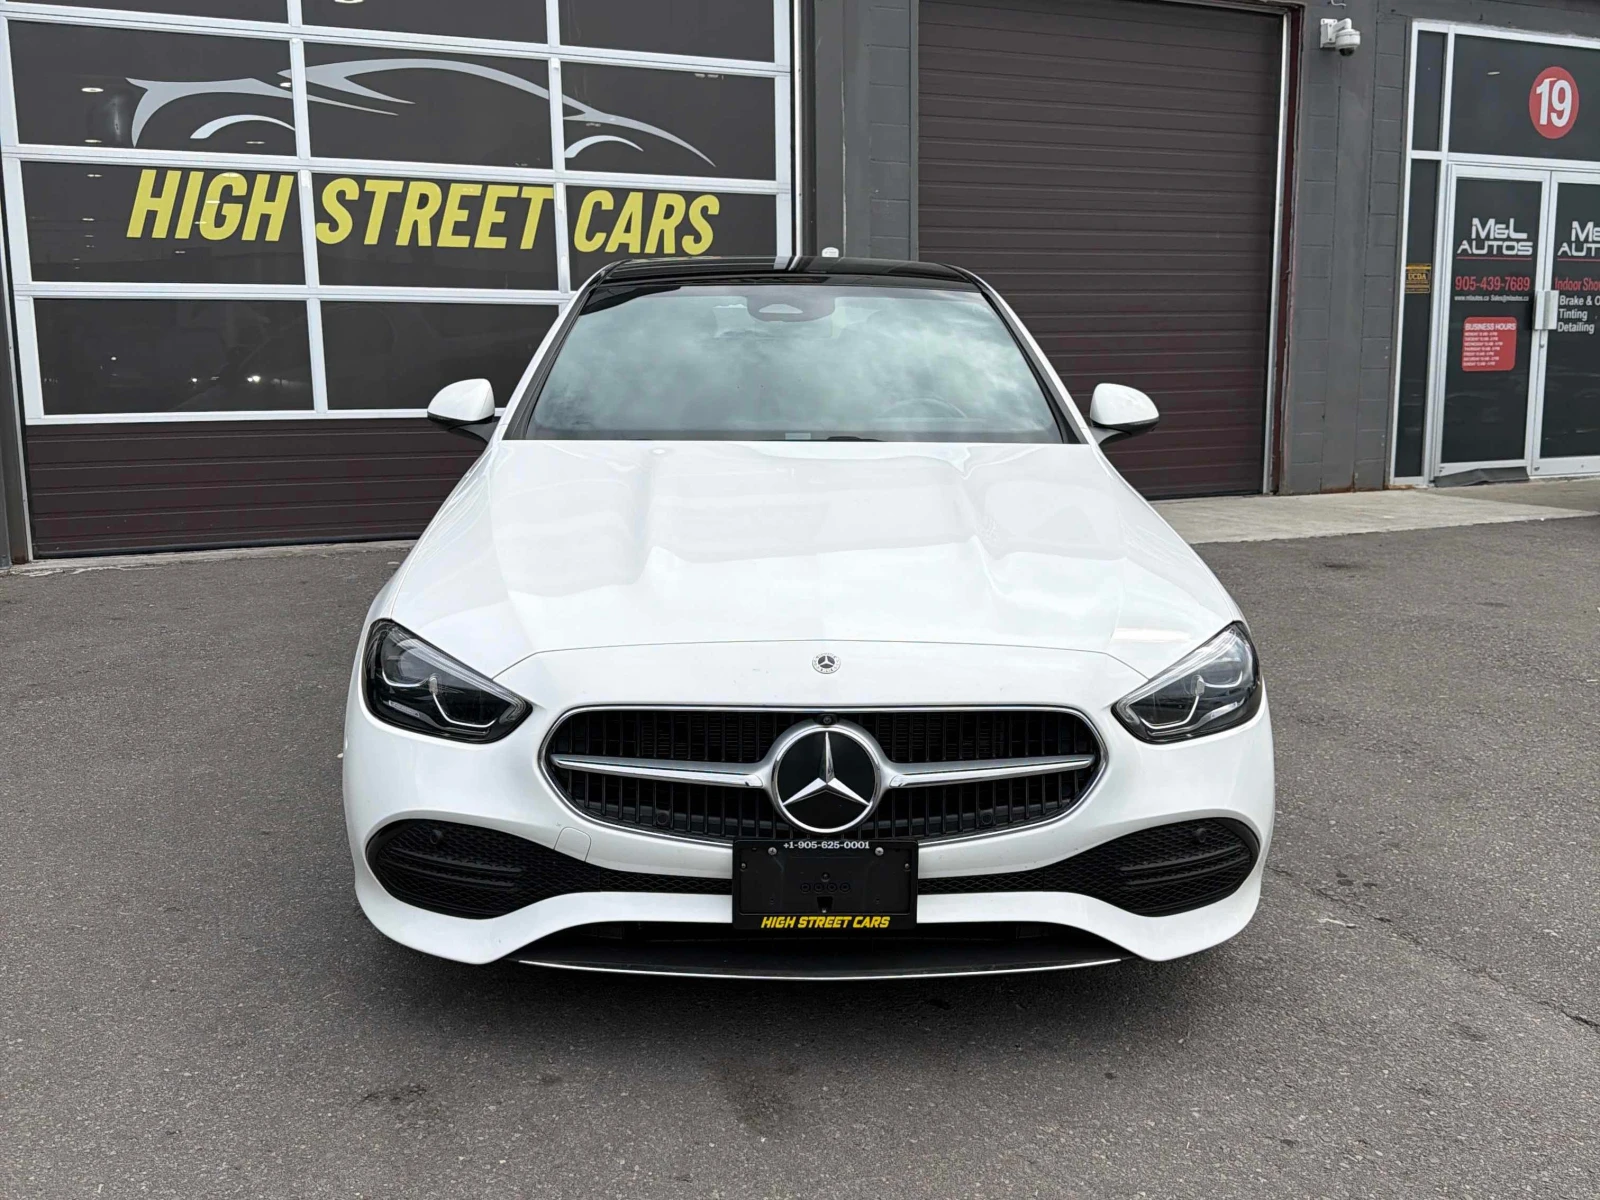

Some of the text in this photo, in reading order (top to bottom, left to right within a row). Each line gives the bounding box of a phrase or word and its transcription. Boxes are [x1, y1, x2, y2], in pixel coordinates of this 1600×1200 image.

[1535, 77, 1573, 128] 19
[126, 168, 721, 256] HIGH STREET CARS
[1471, 217, 1528, 240] M&L
[1456, 240, 1534, 256] AUTOS
[1454, 275, 1531, 292] 905-439-7689
[1554, 276, 1581, 291] Indoor
[1559, 294, 1584, 306] Brake
[1585, 295, 1593, 306] &
[1558, 308, 1588, 321] Tinting
[1464, 322, 1517, 331] BUSINESS HOURS
[1557, 321, 1595, 335] Detailing
[783, 840, 870, 849] +1-905-625-0001
[760, 916, 891, 929] HIGH STREET CARS
